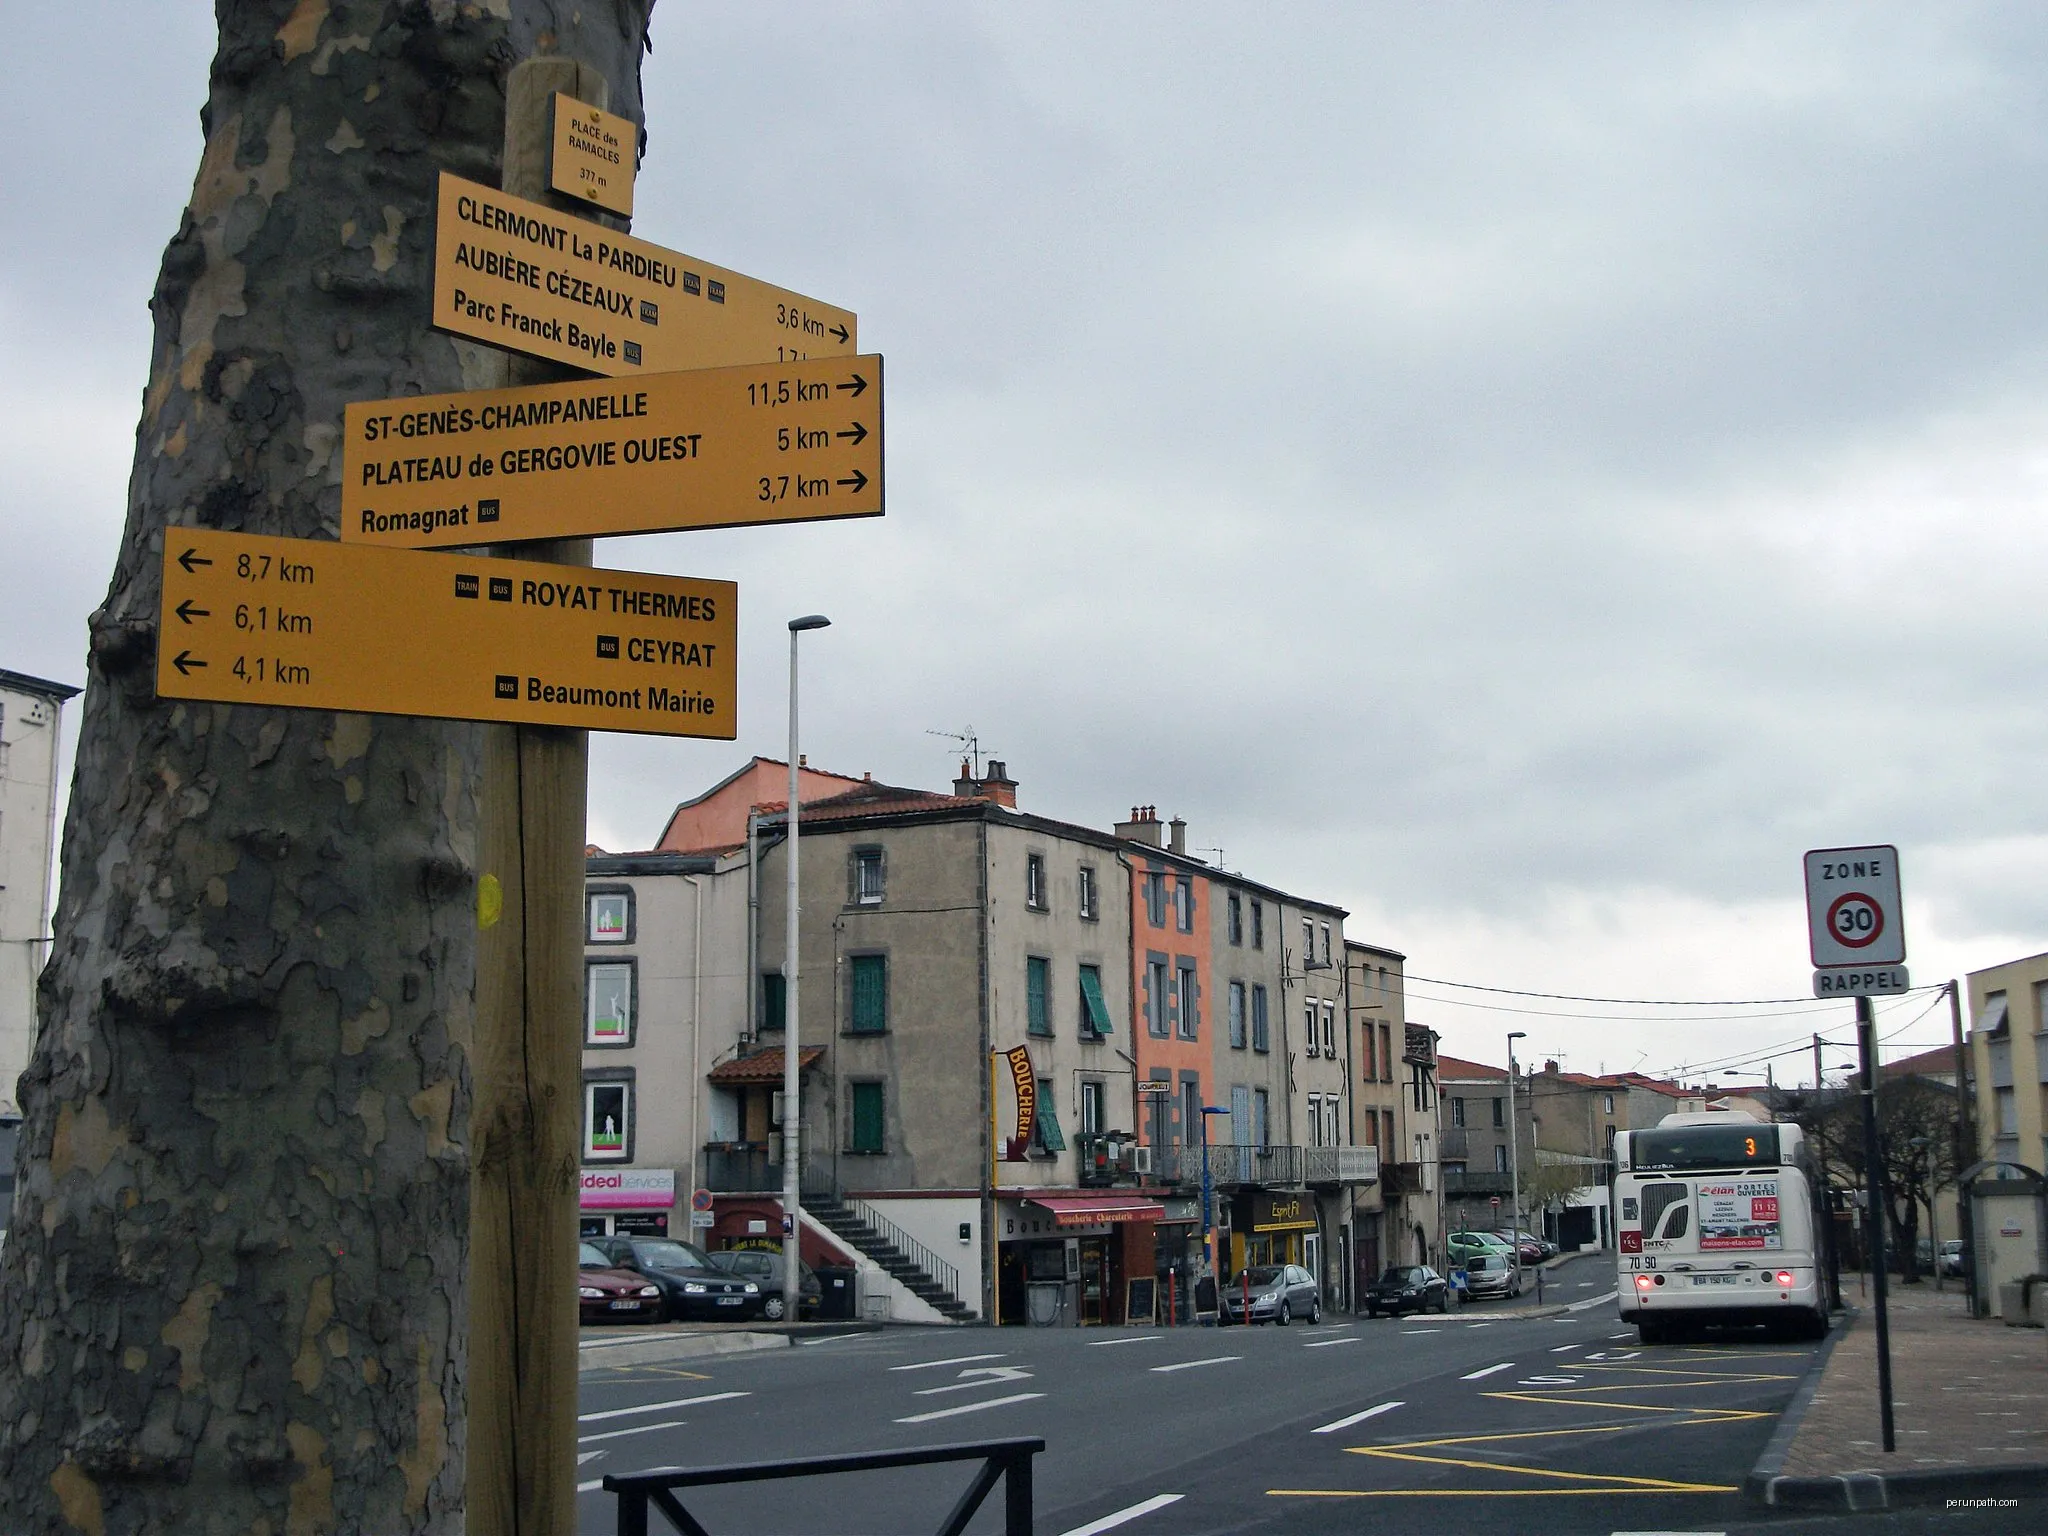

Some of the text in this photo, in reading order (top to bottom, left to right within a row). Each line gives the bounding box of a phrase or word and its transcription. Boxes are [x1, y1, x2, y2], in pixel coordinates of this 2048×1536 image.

[569, 135, 619, 164] RAMACLES
[572, 119, 618, 146] PLACE des
[580, 168, 606, 187] 377 m
[455, 243, 540, 289] AUBIÈRE
[547, 269, 633, 318] CÉZEAUX
[641, 307, 657, 319] TRAM
[458, 196, 824, 337] CLERMONT La PARDIEU TRAIN TRAM 3,6 km
[455, 289, 639, 358] Parc Franck Bayle BUS
[365, 379, 828, 441] ST-GENÈS-CHAMPANELLE 11,5 km
[363, 427, 828, 486] PLATEAU de GERGOVIE OUEST 5 km
[362, 475, 828, 533] Romagnat BUS 3,7 km
[237, 554, 715, 621] 8,7 km TRAIN BUS ROYAT THERMES
[235, 604, 716, 667] 6,1 km BUS CEYRAT
[233, 656, 714, 714] 4,1 km BUS Beaumont Mairie
[1822, 861, 1882, 880] ZONE
[1838, 907, 1873, 932] 30
[1820, 971, 1903, 991] RAPPEL
[1009, 1047, 1034, 1138] BOUCHERIE
[1744, 1138, 1756, 1156] 3
[1710, 1186, 1734, 1195] élan
[1754, 1203, 1777, 1211] 11 12
[1629, 1256, 1656, 1269] 70 90
